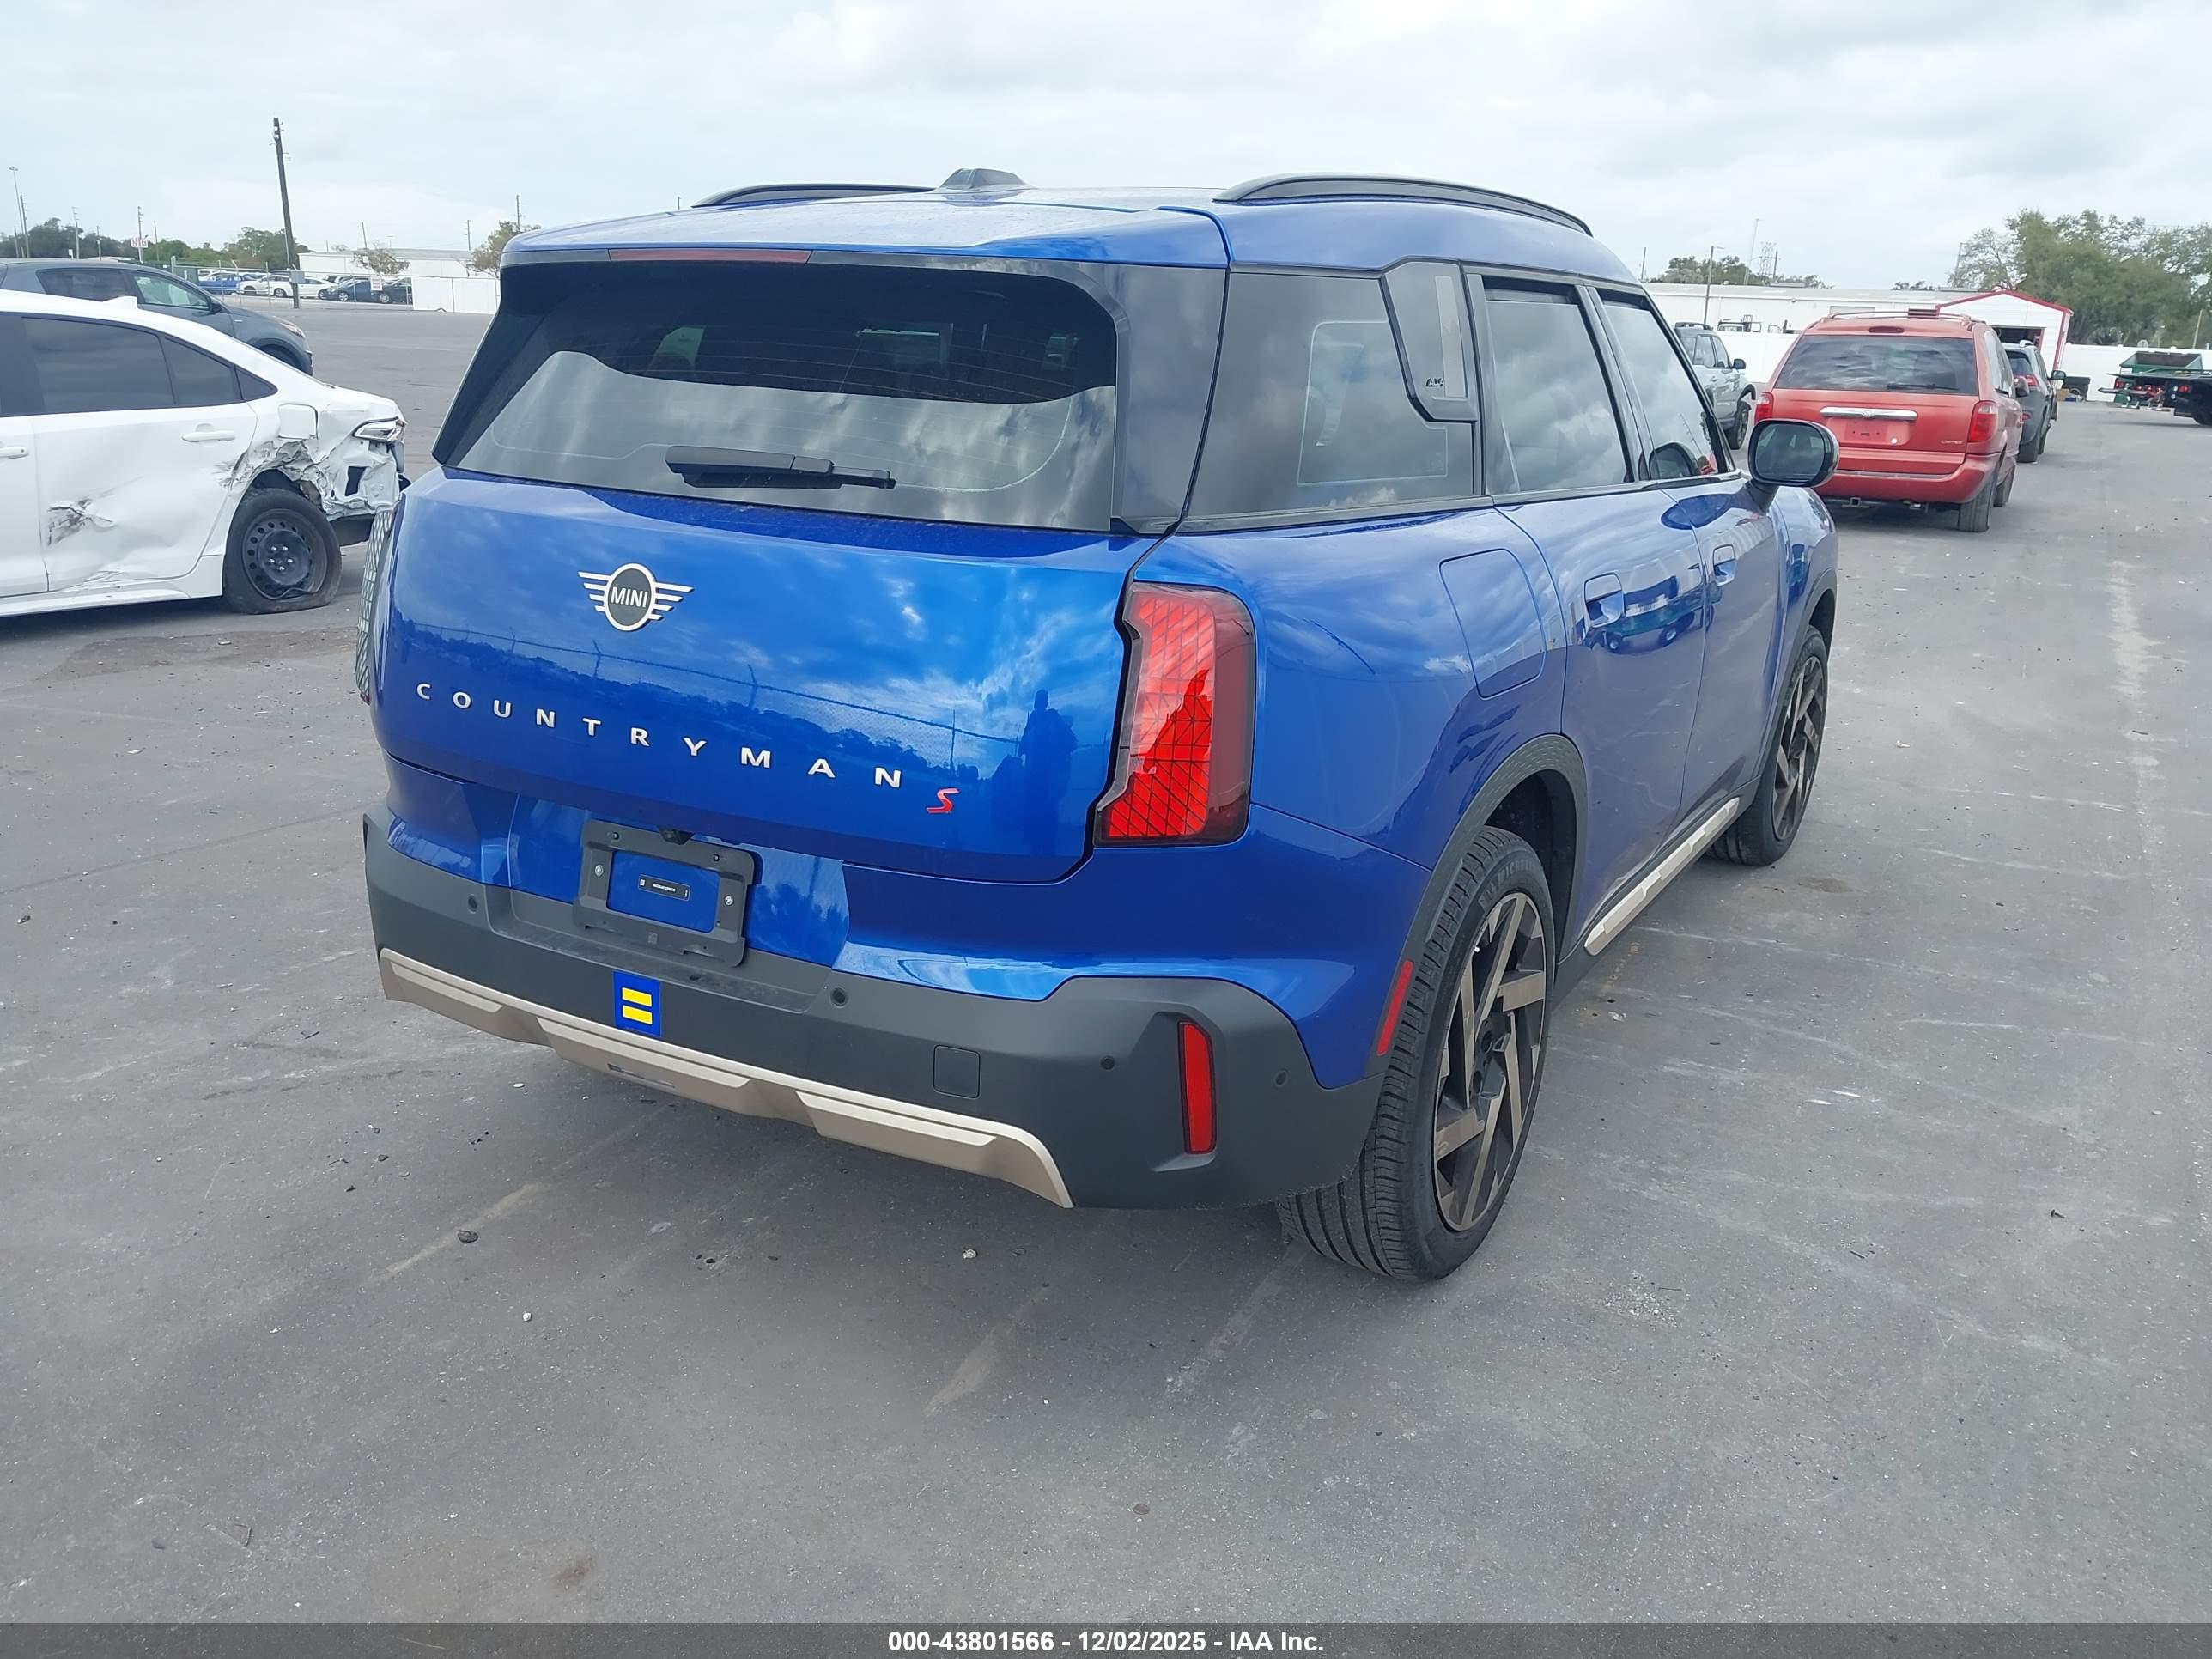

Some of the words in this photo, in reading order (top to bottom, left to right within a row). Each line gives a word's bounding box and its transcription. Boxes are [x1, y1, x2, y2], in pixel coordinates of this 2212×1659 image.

[610, 586, 648, 608] MINI
[416, 683, 902, 788] COUNTRYMAN
[926, 787, 960, 814] S
